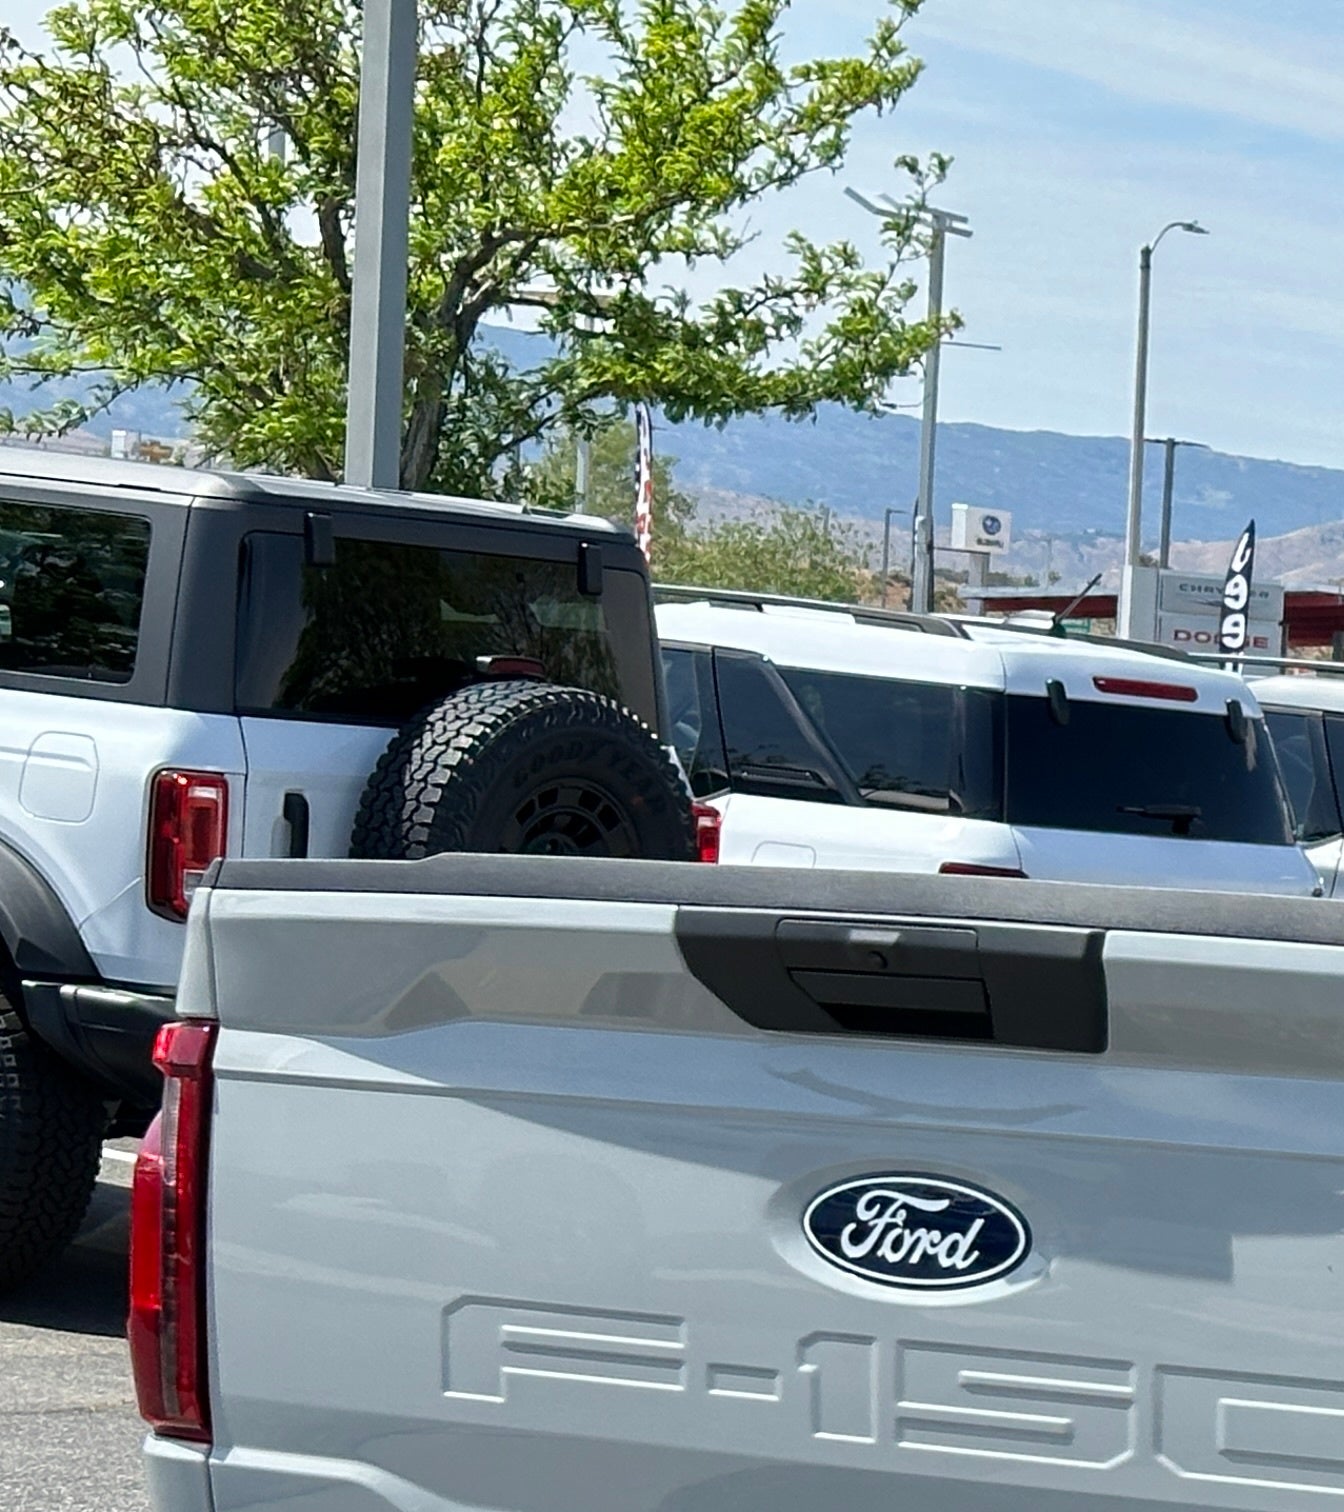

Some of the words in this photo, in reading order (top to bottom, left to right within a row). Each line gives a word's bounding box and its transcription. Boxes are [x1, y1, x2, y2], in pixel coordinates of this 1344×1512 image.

[1179, 582, 1269, 600] CHRYER
[1173, 629, 1269, 649] DOE
[841, 1188, 986, 1271] Ford
